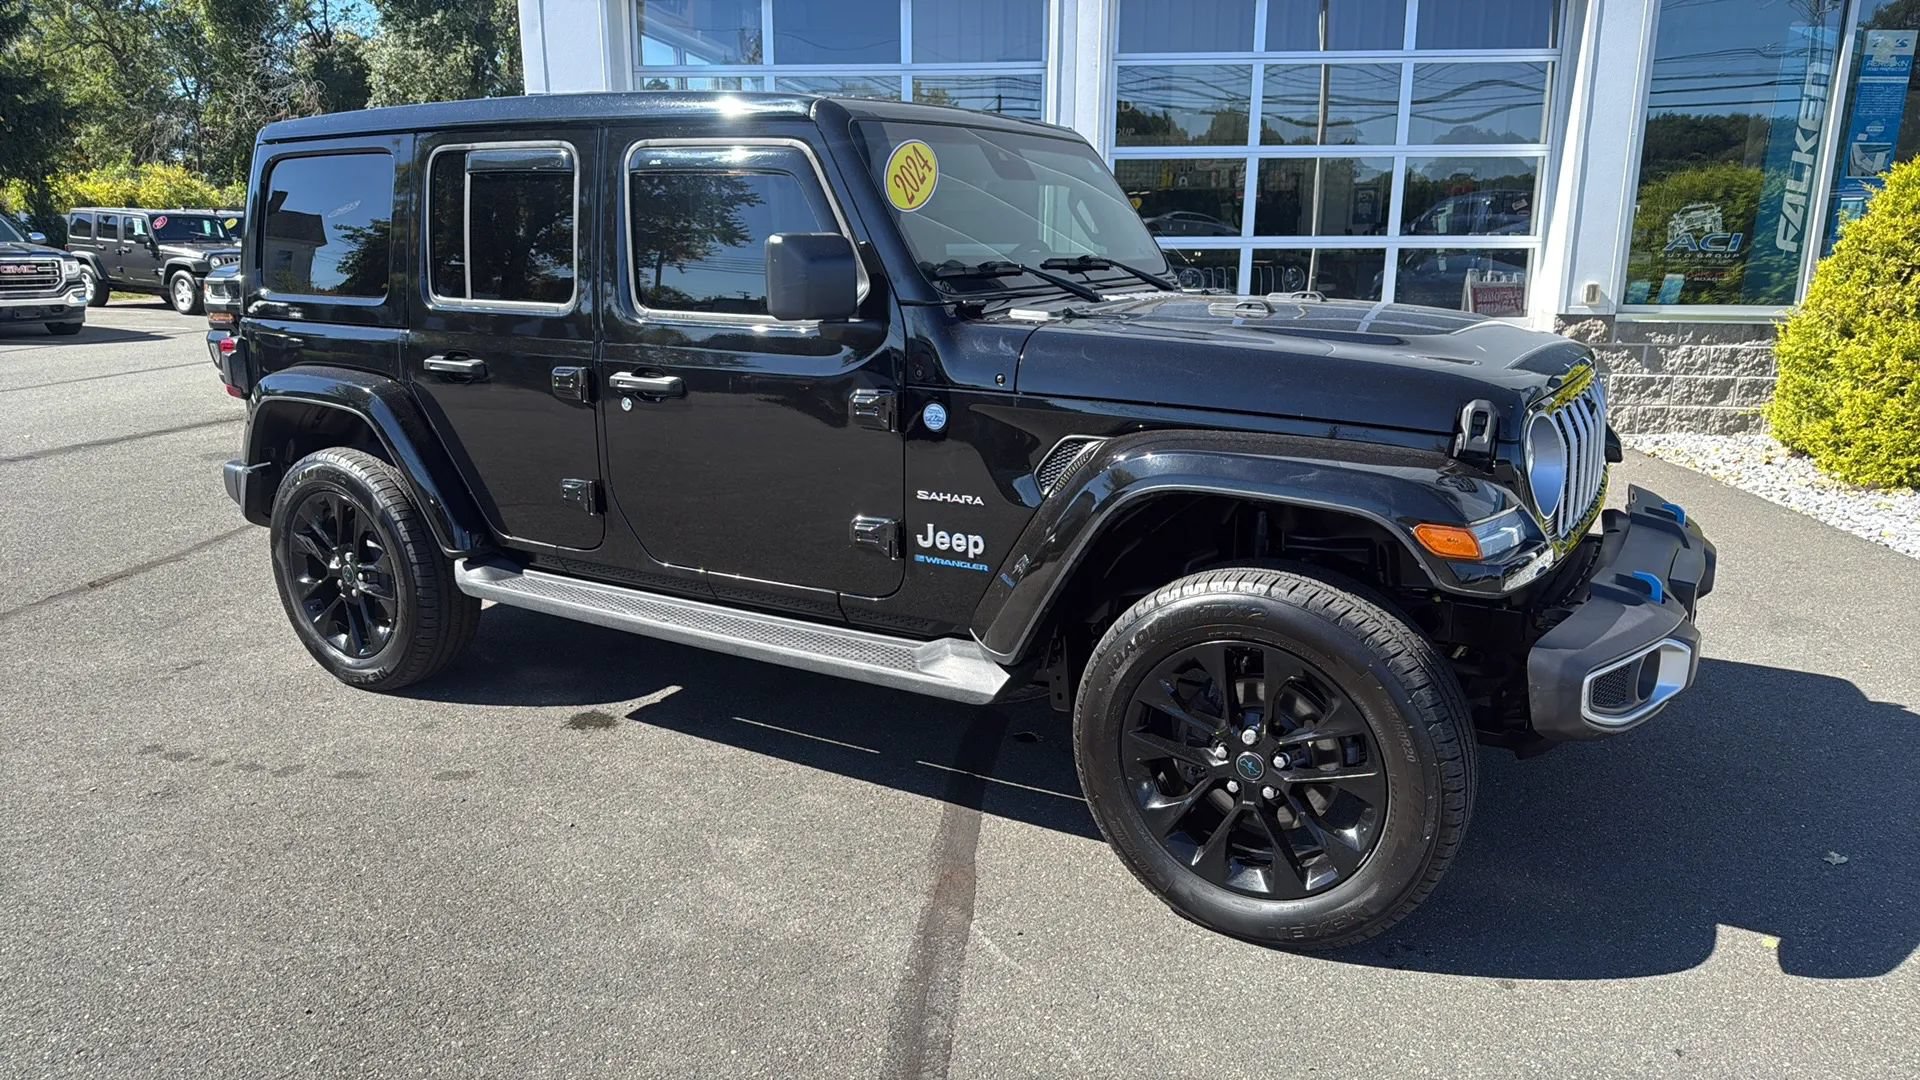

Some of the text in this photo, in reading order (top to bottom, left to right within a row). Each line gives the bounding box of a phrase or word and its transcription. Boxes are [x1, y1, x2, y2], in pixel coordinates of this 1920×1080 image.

[1775, 61, 1830, 253] FALKEN
[893, 145, 932, 205] 2024
[1663, 232, 1744, 252] ACI
[0, 264, 37, 274] GMC
[916, 489, 985, 506] SAHARA
[916, 523, 985, 559] Jeep
[925, 555, 989, 572] WRANGLER
